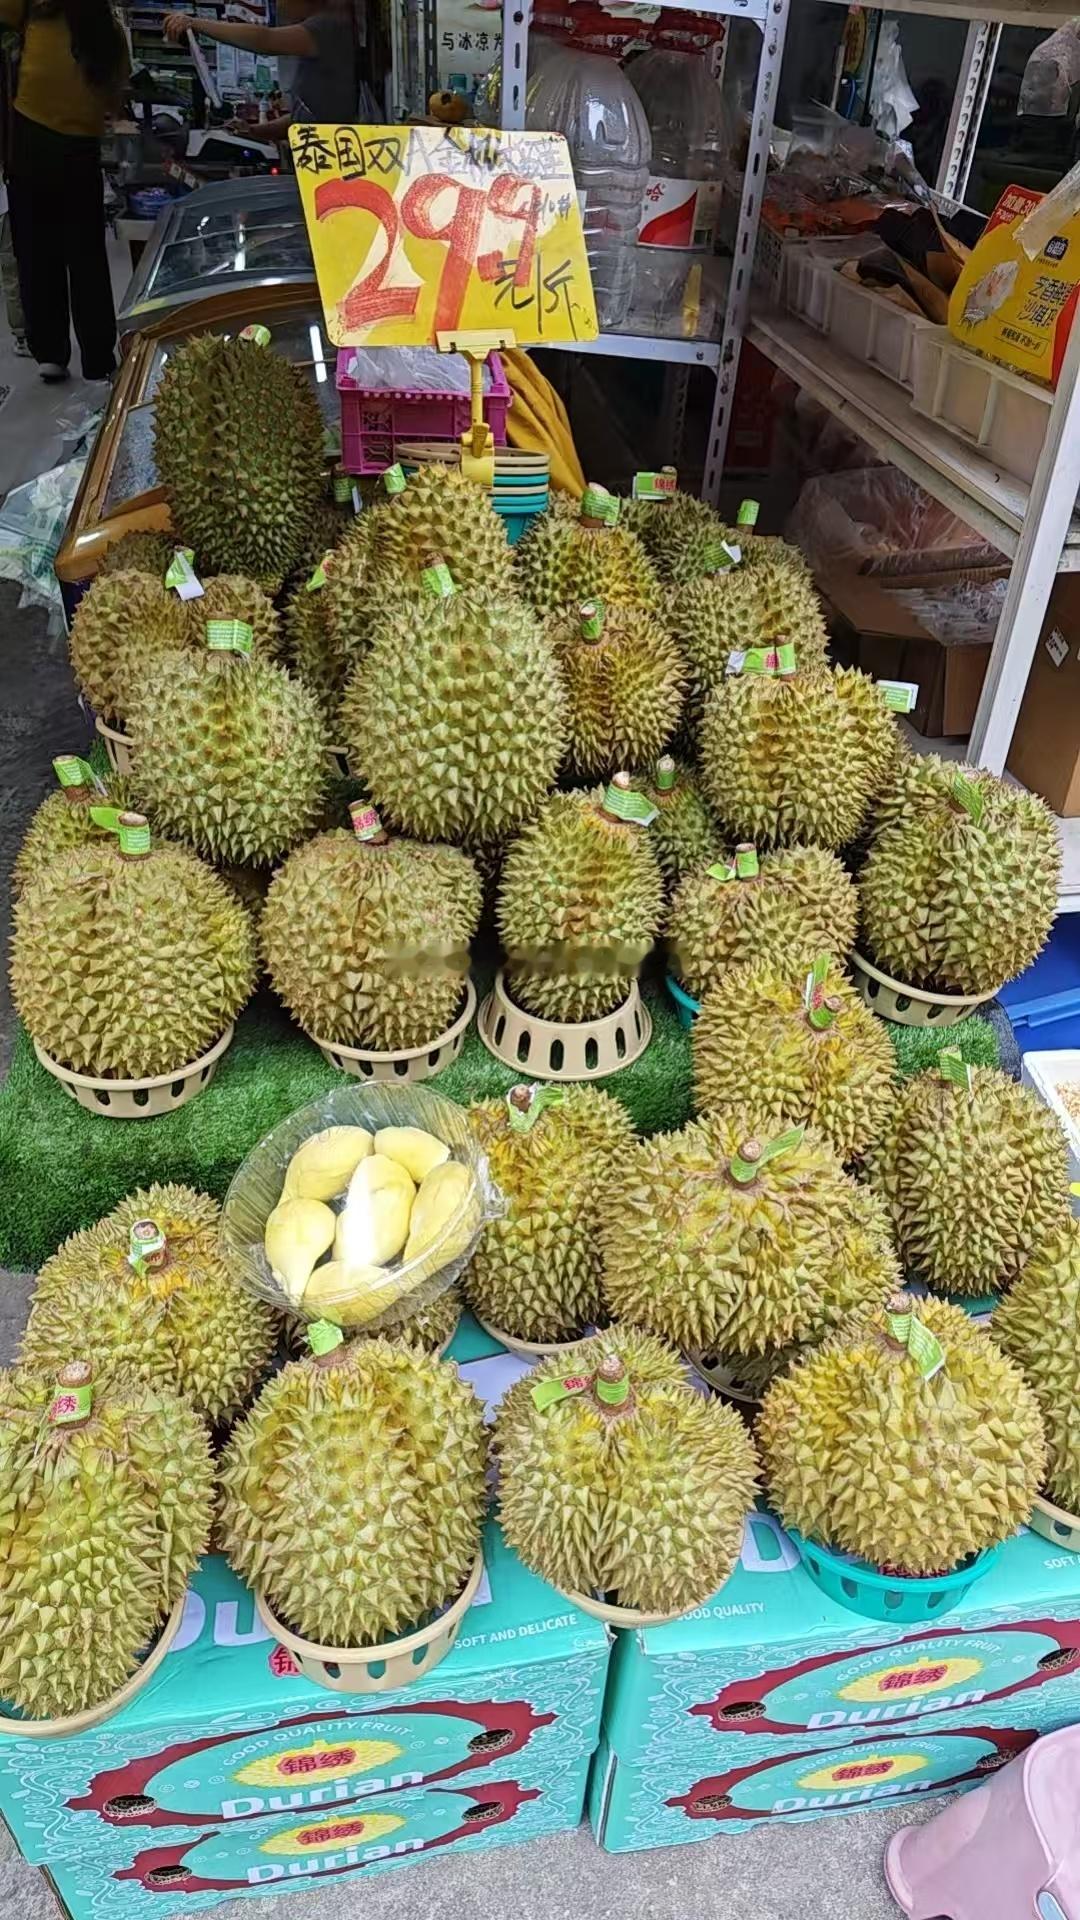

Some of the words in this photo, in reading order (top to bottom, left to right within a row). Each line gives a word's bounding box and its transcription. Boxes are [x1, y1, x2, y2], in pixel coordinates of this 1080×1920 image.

[315, 172, 542, 344] 29.9
[1043, 1554, 1076, 1569] SOFT
[713, 1602, 765, 1618] QUALITY
[454, 1635, 487, 1649] SOFT
[489, 1628, 517, 1643] AND
[518, 1613, 577, 1637] DELICATE
[836, 1655, 885, 1681] GOOD
[889, 1639, 963, 1657] QUALITY
[964, 1639, 1002, 1654] FRUIT
[882, 1664, 947, 1690] 锦绣
[807, 1688, 987, 1730] Durian
[223, 1740, 269, 1766] GOOD
[273, 1721, 359, 1742] QUALITY
[360, 1721, 412, 1737] FRUIT
[283, 1749, 354, 1775] 锦绣
[221, 1770, 424, 1819] Durian
[771, 1779, 934, 1814] Durian
[247, 1837, 425, 1884] Durian
